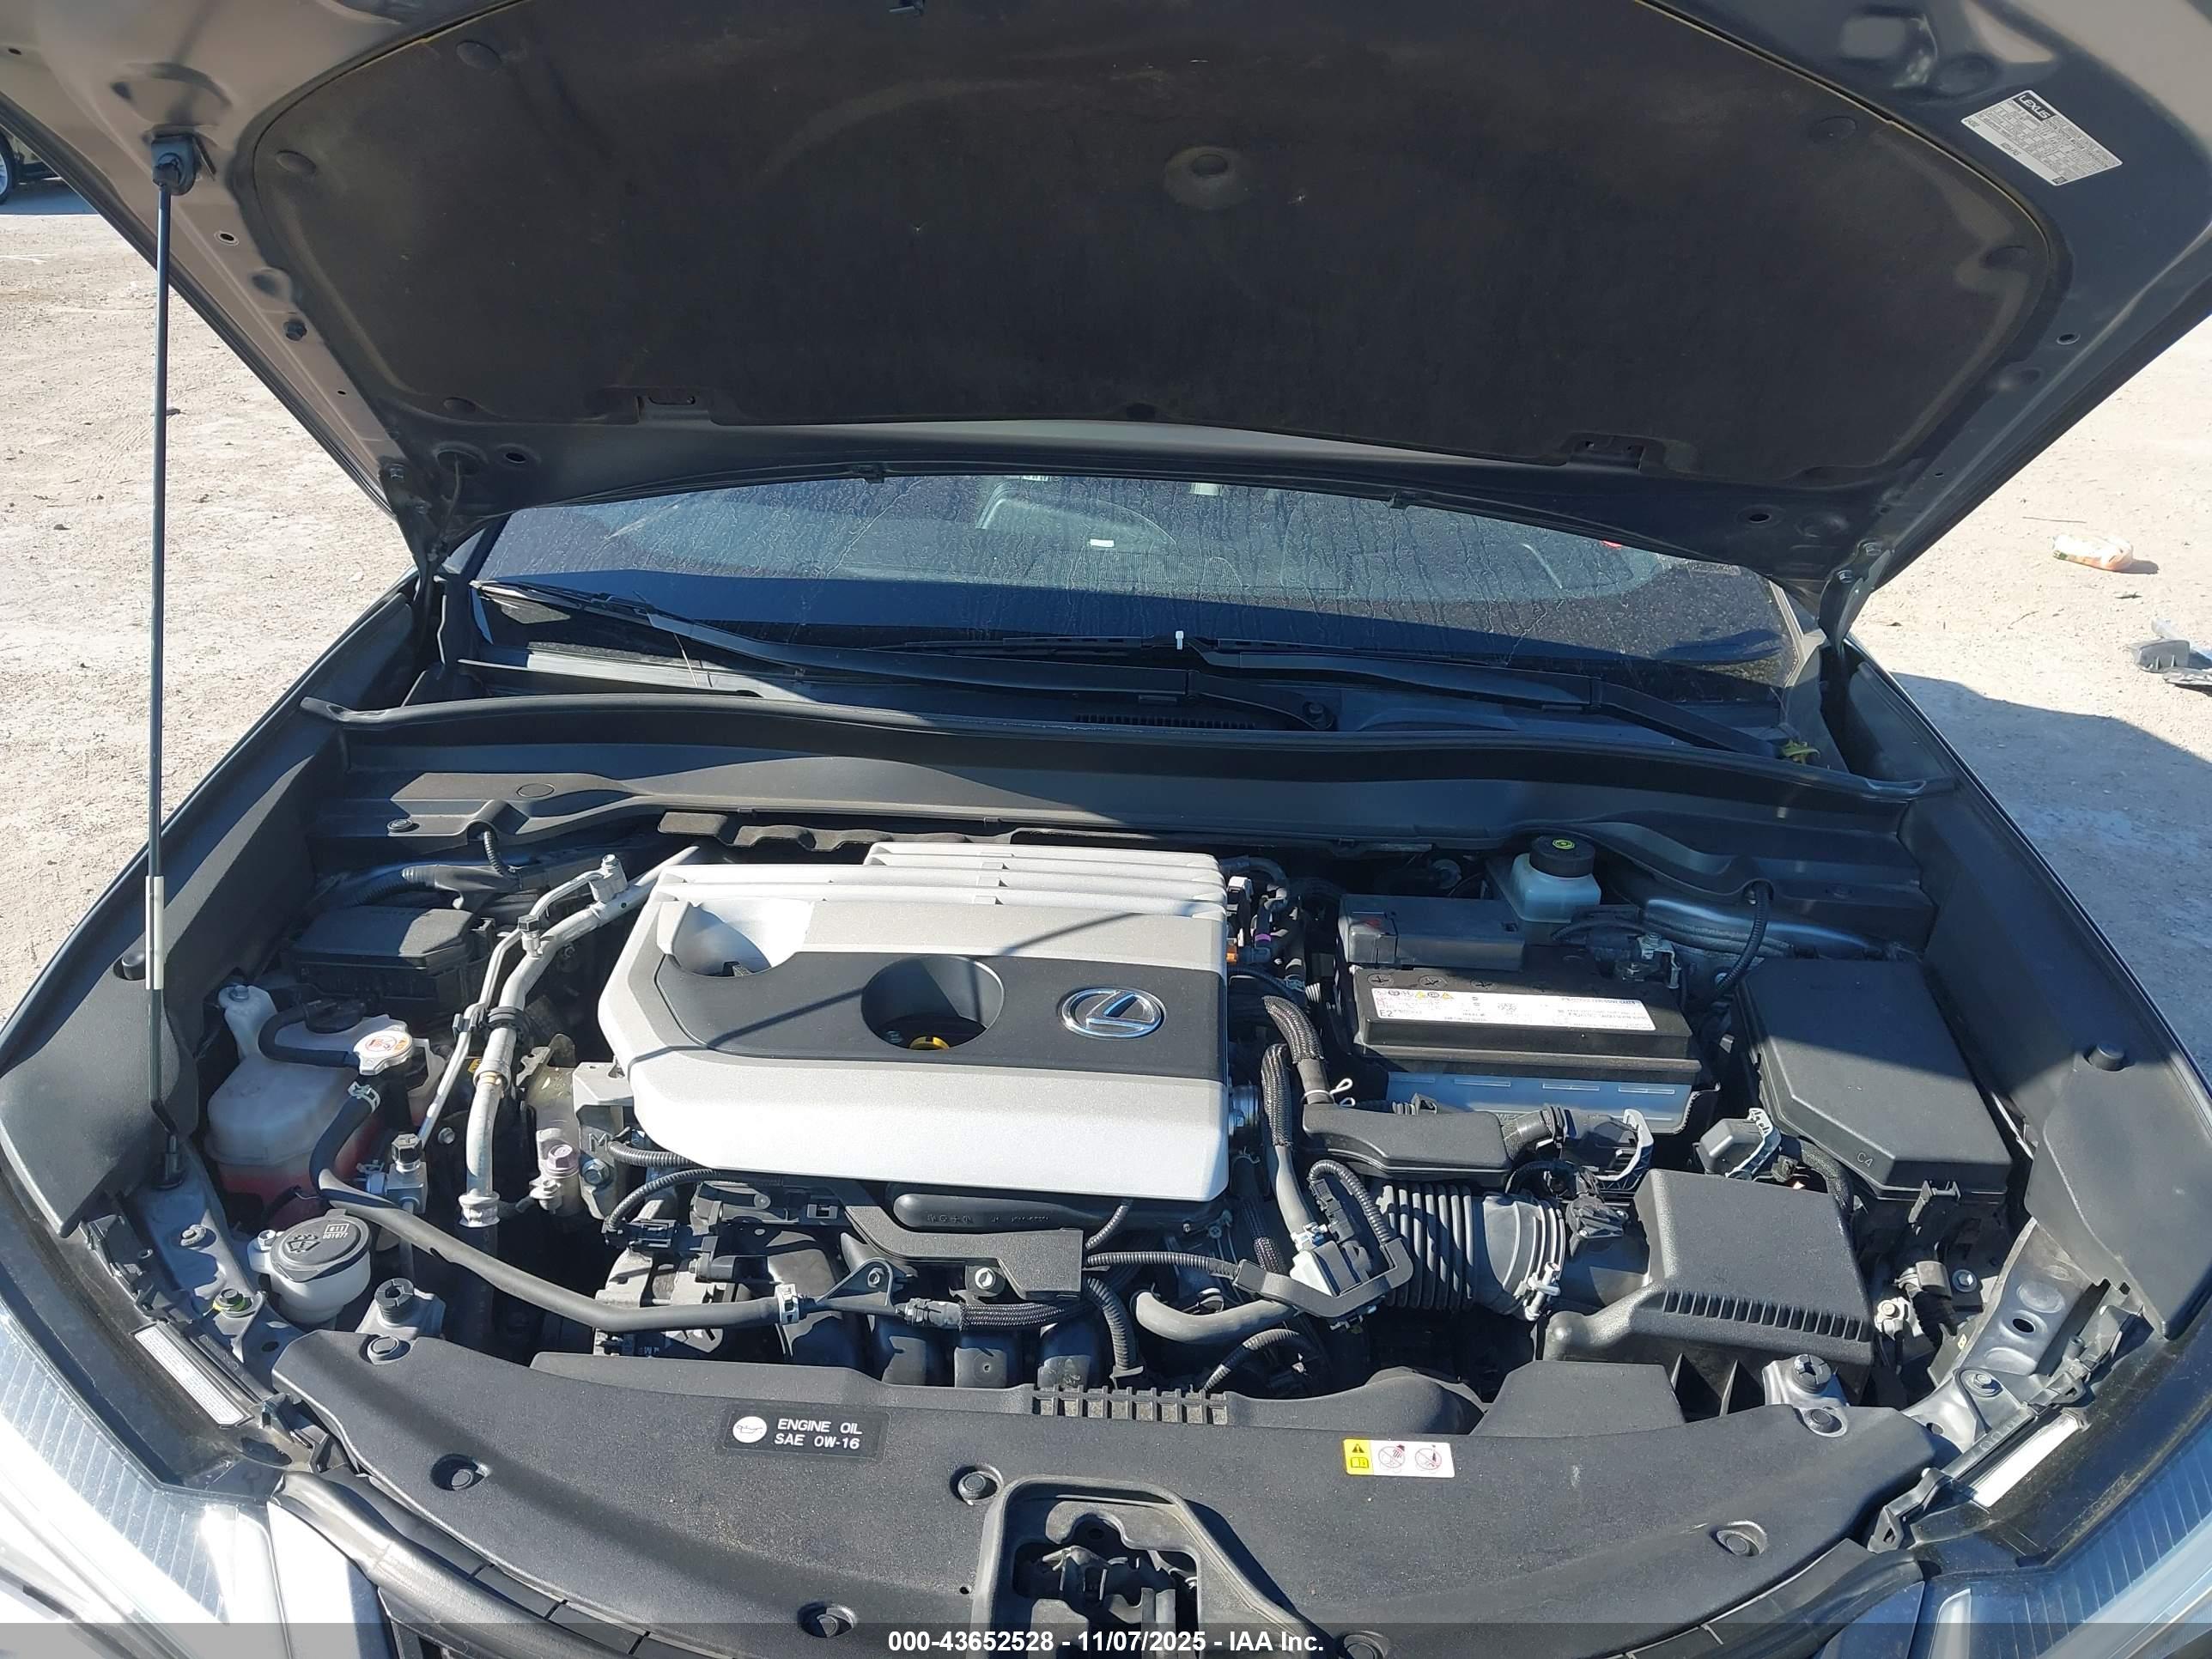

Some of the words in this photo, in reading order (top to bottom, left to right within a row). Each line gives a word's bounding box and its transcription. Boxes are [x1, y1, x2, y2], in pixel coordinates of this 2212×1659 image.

[2019, 94, 2051, 119] LEXUS
[1856, 1152, 1874, 1168] C4
[777, 1419, 832, 1433] ENGINE
[840, 1422, 864, 1435] OIL
[774, 1433, 805, 1446] SAE
[814, 1436, 860, 1449] 0W-16
